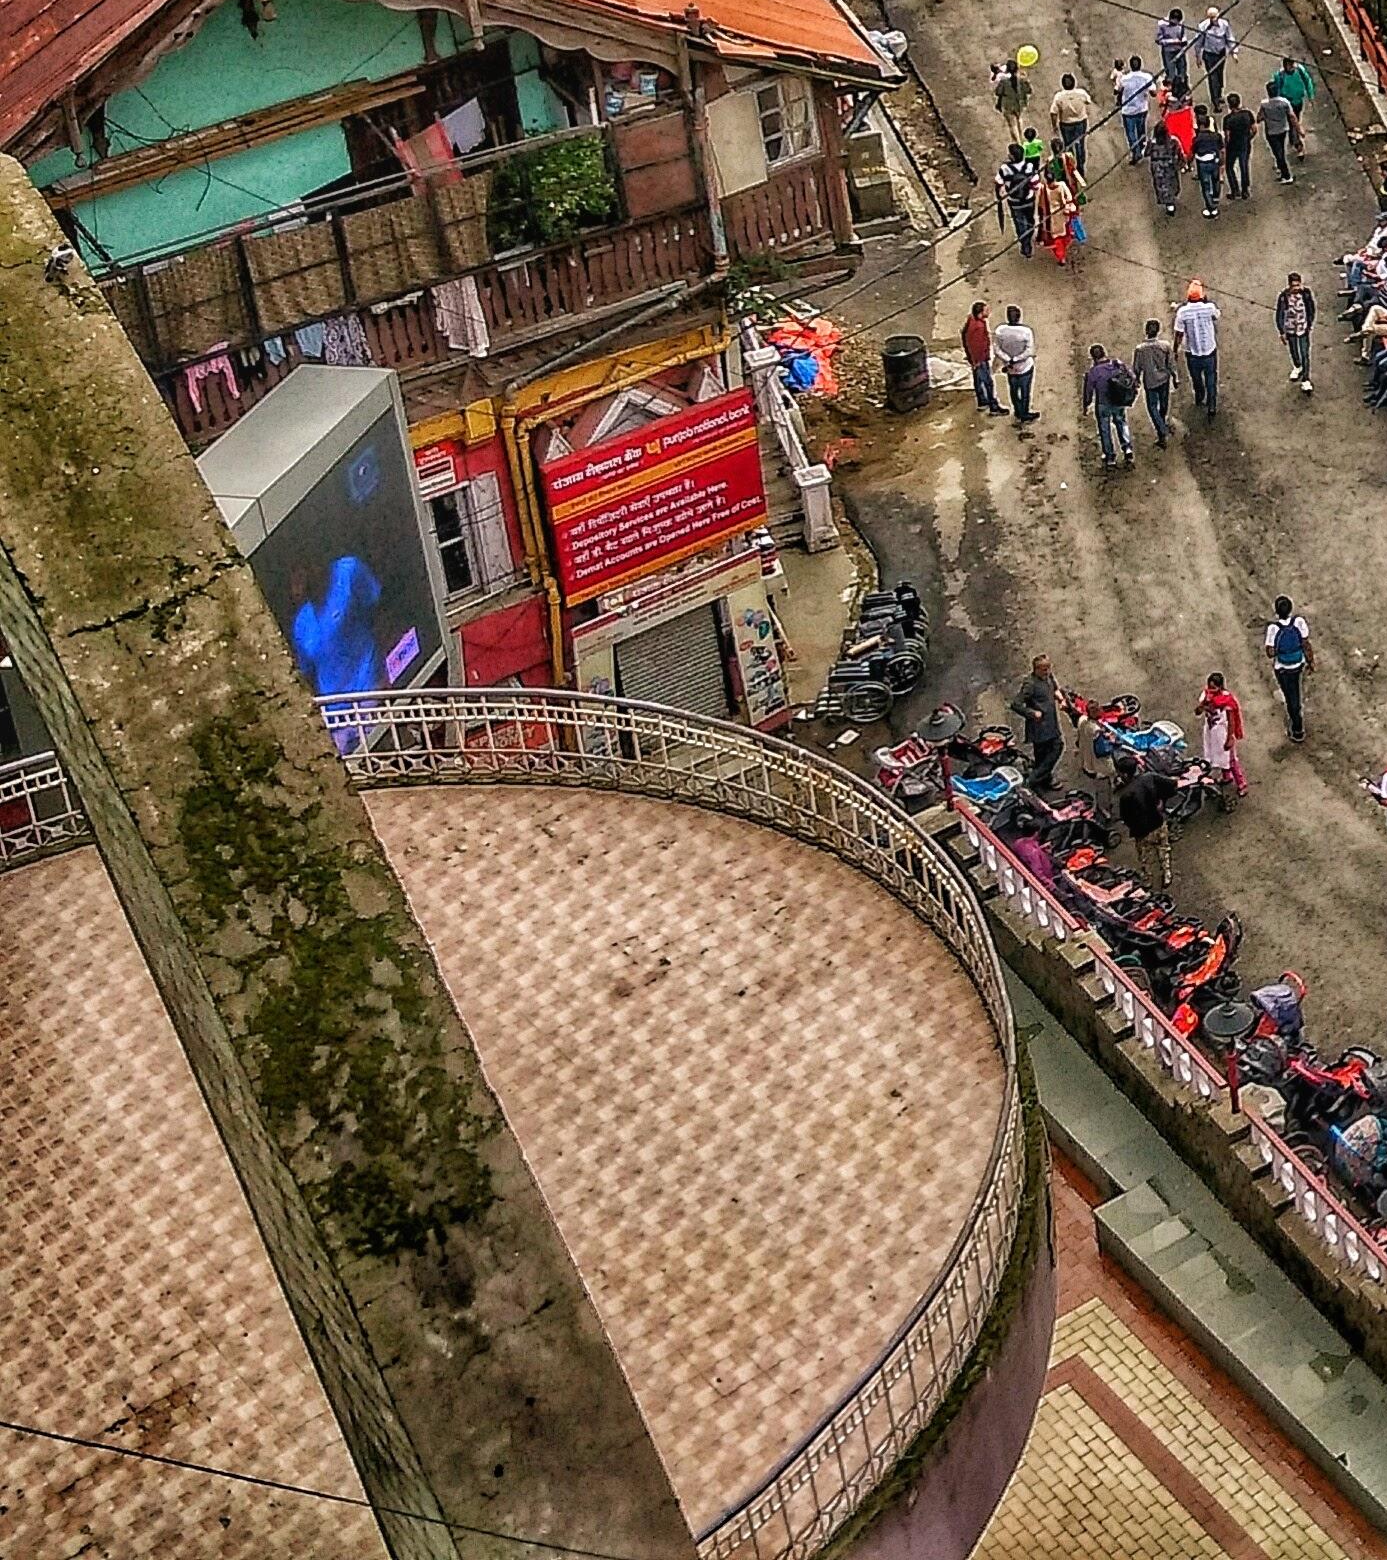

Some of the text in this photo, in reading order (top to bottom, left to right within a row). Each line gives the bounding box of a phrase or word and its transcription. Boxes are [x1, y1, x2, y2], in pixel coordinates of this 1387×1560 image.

[618, 514, 654, 532] Services
[655, 505, 669, 516] are
[669, 489, 706, 510] Available
[576, 562, 604, 579] Demat
[604, 544, 643, 567] Accounts
[644, 539, 658, 551] are
[658, 524, 691, 544] Opened
[692, 516, 711, 531] Here
[711, 509, 730, 523] Free
[731, 503, 741, 514] of
